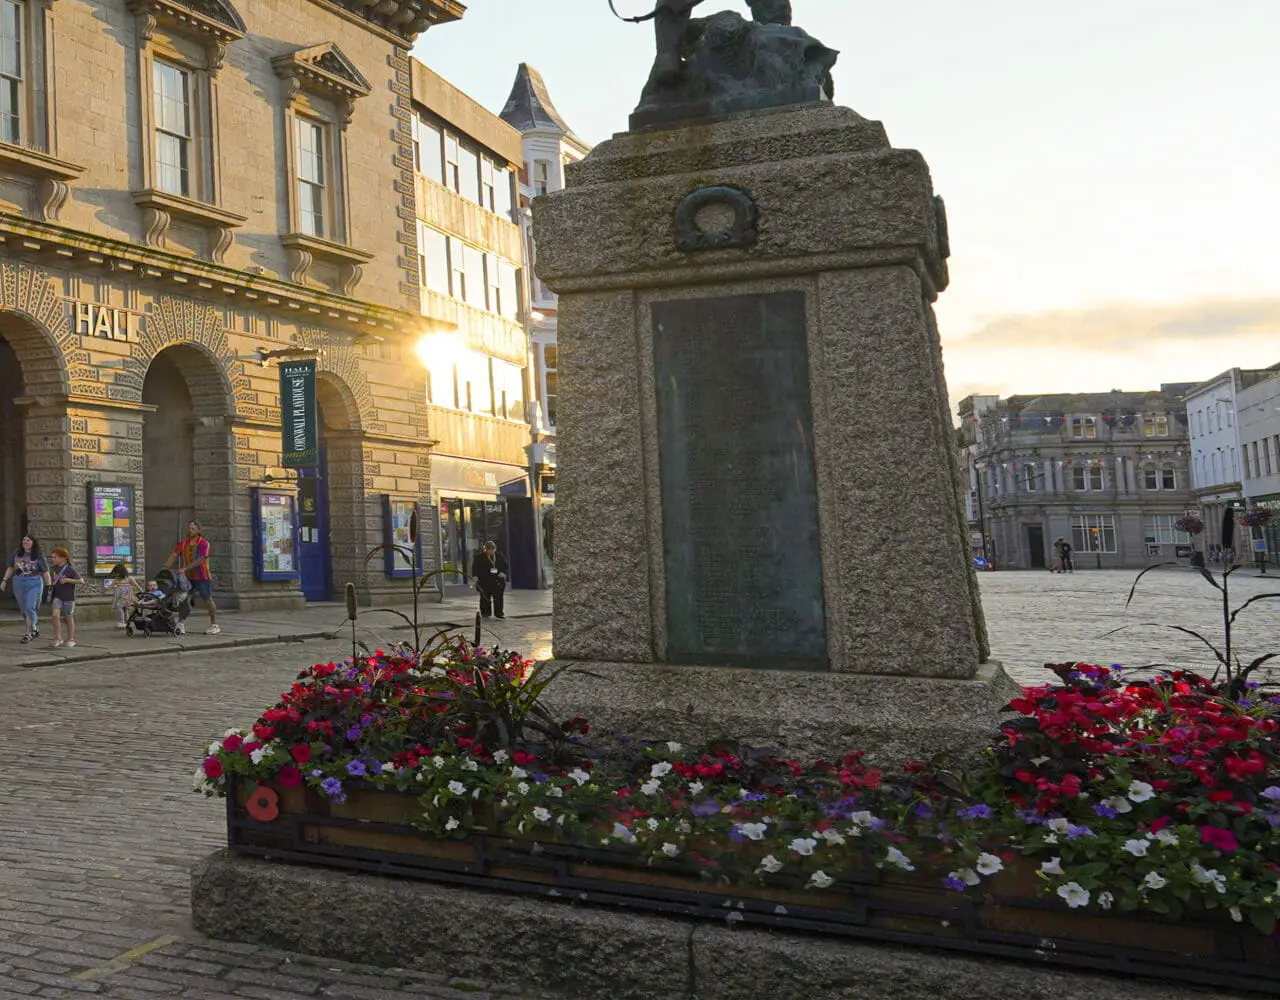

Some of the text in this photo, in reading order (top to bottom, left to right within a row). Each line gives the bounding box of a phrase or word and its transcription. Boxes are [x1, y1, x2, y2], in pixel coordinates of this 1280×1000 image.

[75, 301, 140, 344] HALL
[292, 377, 306, 417] PLAYHOUSE
[293, 417, 307, 451] CORNWALL
